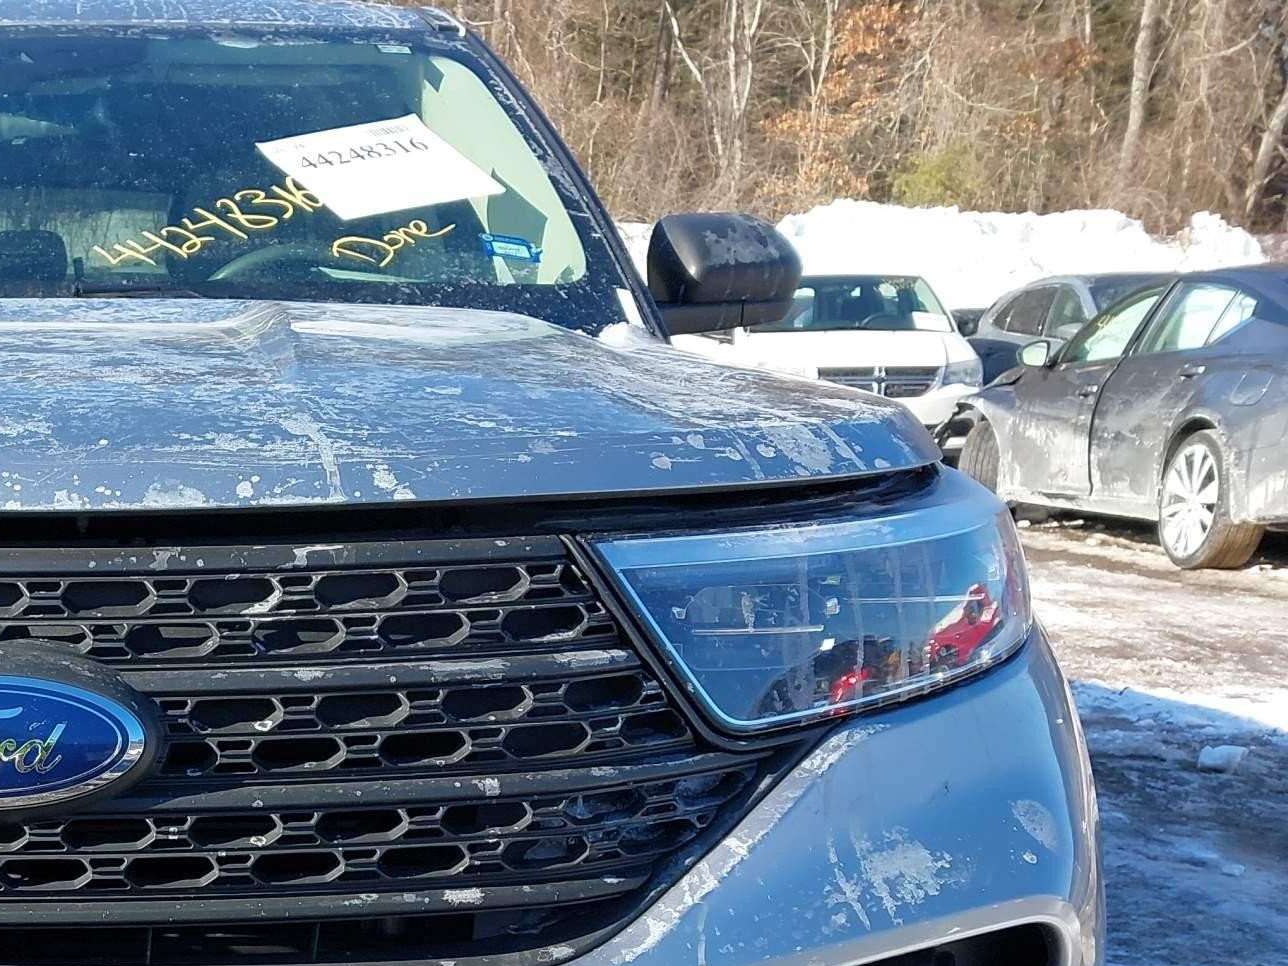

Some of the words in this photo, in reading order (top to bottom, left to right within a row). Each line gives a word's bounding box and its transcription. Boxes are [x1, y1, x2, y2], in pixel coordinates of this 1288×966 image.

[300, 136, 429, 169] 44248316
[93, 175, 324, 266] 44248316
[332, 219, 456, 267] Done
